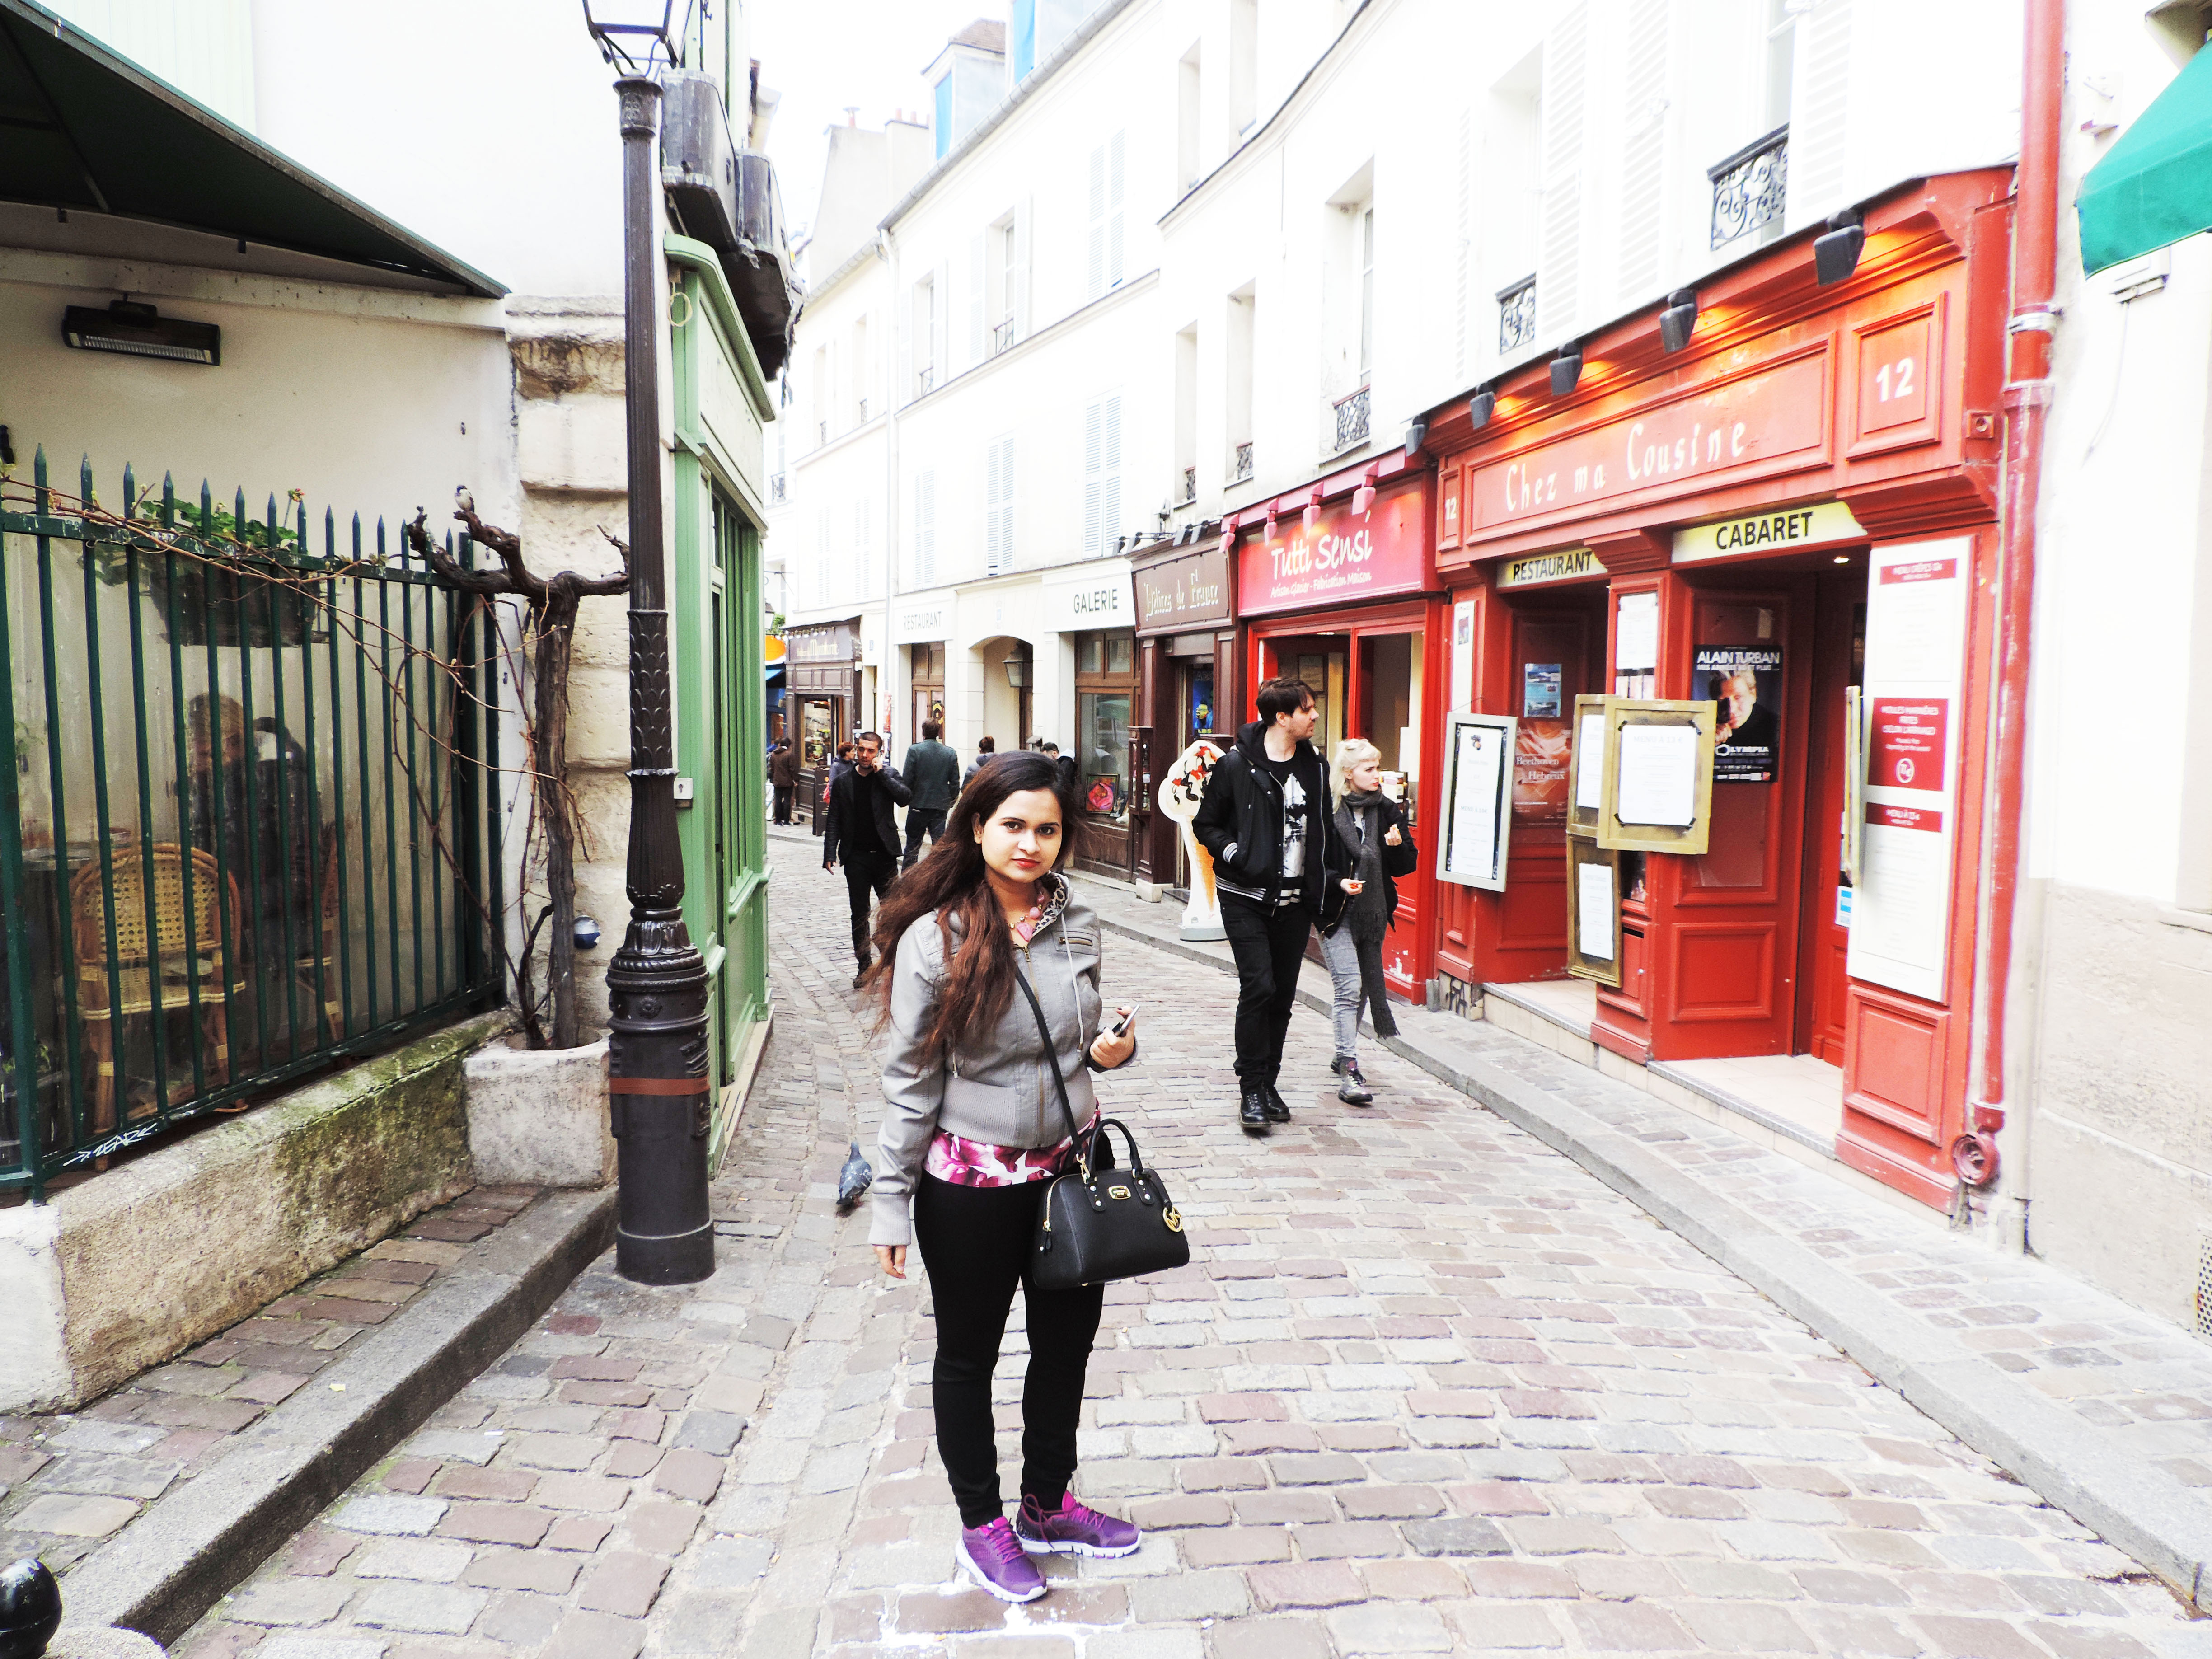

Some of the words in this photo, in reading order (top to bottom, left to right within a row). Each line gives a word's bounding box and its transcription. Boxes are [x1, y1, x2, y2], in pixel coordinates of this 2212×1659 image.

[1876, 357, 1913, 403] 12
[1505, 463, 1557, 512] Chez
[1574, 464, 1606, 493] ma
[1626, 422, 1747, 481] Cousine
[1445, 496, 1457, 520] 12
[1271, 529, 1312, 580] Tutti
[1315, 510, 1373, 570] Sensi
[1716, 511, 1814, 550] CABARET
[1513, 550, 1593, 582] RESTAURANT
[1073, 588, 1118, 614] GALERIE
[904, 611, 942, 631] RESTAURANT
[1697, 651, 1734, 664] ALAIN
[1735, 651, 1780, 664] TURBAN
[1715, 744, 1769, 757] OLYMPIA
